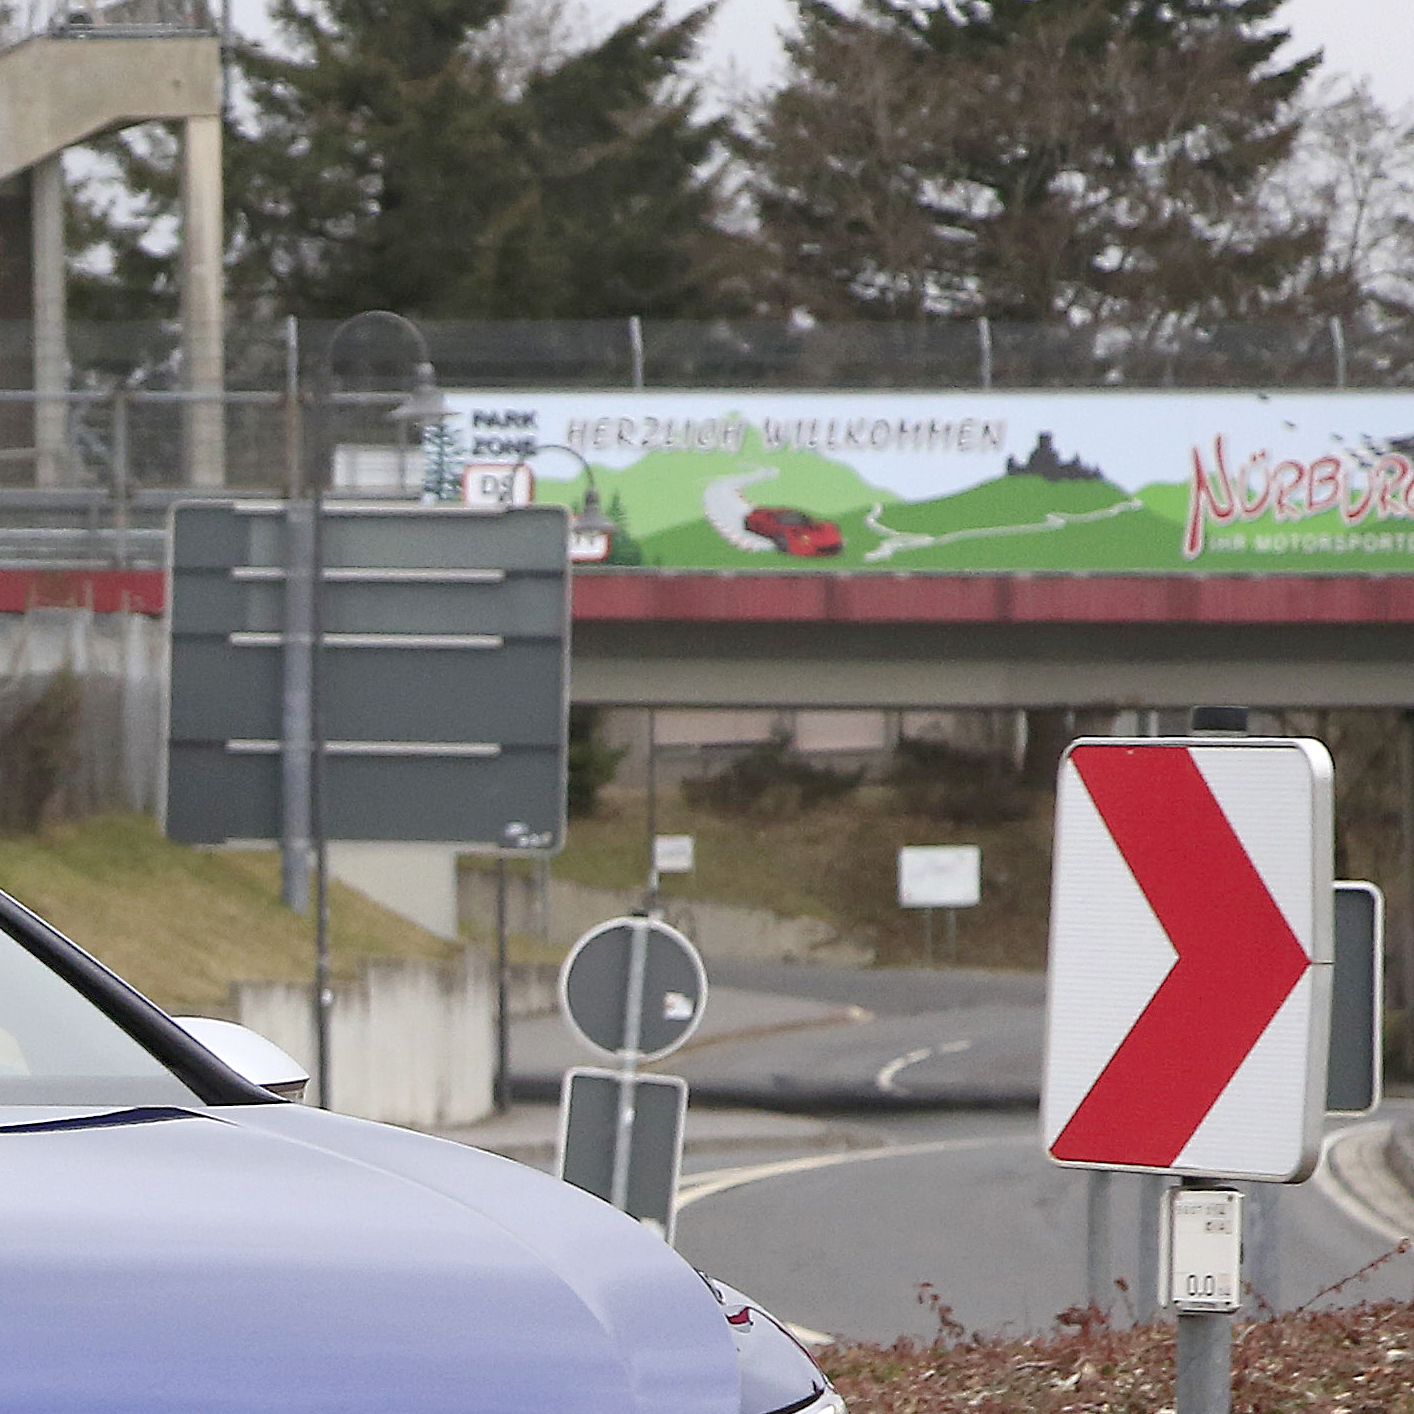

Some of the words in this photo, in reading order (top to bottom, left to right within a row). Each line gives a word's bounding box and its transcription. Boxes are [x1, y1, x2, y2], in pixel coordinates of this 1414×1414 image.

[473, 409, 538, 428] PARK
[473, 436, 537, 456] ZONE
[566, 416, 747, 453] HERZLICH
[762, 416, 1008, 453] WILLKOMMEN
[1180, 431, 1414, 561] NÜRBUR
